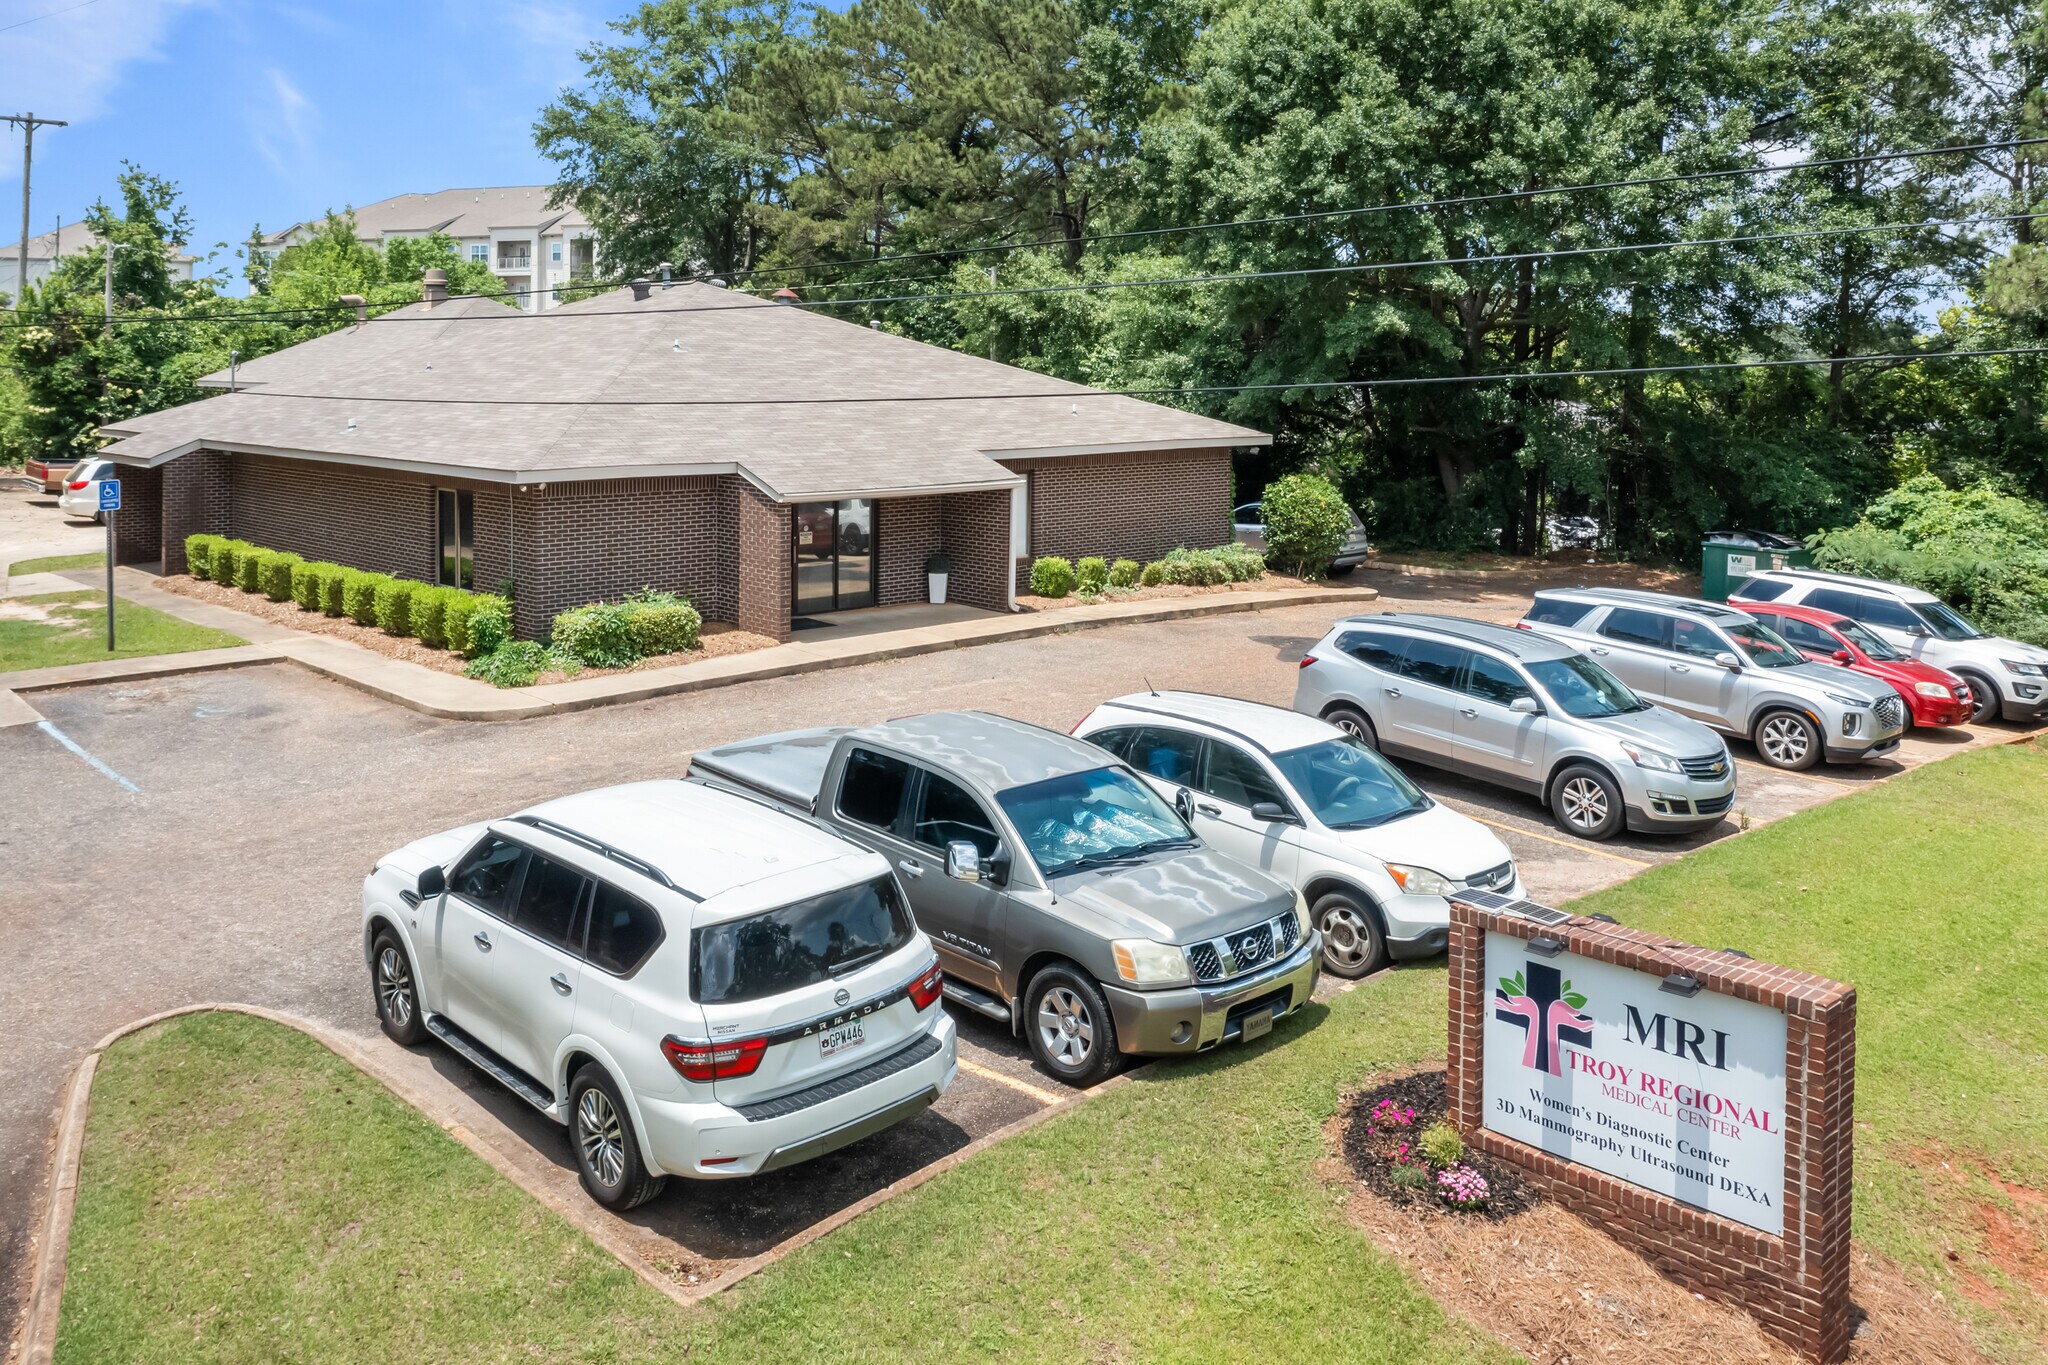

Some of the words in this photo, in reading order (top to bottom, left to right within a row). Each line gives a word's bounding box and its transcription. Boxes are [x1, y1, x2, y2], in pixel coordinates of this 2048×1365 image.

[959, 937, 991, 955] TITAN
[803, 1000, 886, 1036] ARMADA
[829, 1024, 864, 1048] GPW446
[1622, 1003, 1731, 1072] MRI
[1566, 1049, 1634, 1087] TROY
[1640, 1071, 1779, 1136] REGIONAL
[1601, 1083, 1673, 1118] MEDICAL
[1677, 1107, 1743, 1141] CENTER
[1496, 1098, 1515, 1115] 3D
[1519, 1105, 1626, 1157] Mammography
[1630, 1145, 1714, 1187] Ultrasound
[1720, 1176, 1772, 1208] DEXA
[1529, 1088, 1592, 1121] Women's
[1596, 1111, 1673, 1149] Diagnostic
[1677, 1139, 1731, 1168] Center
